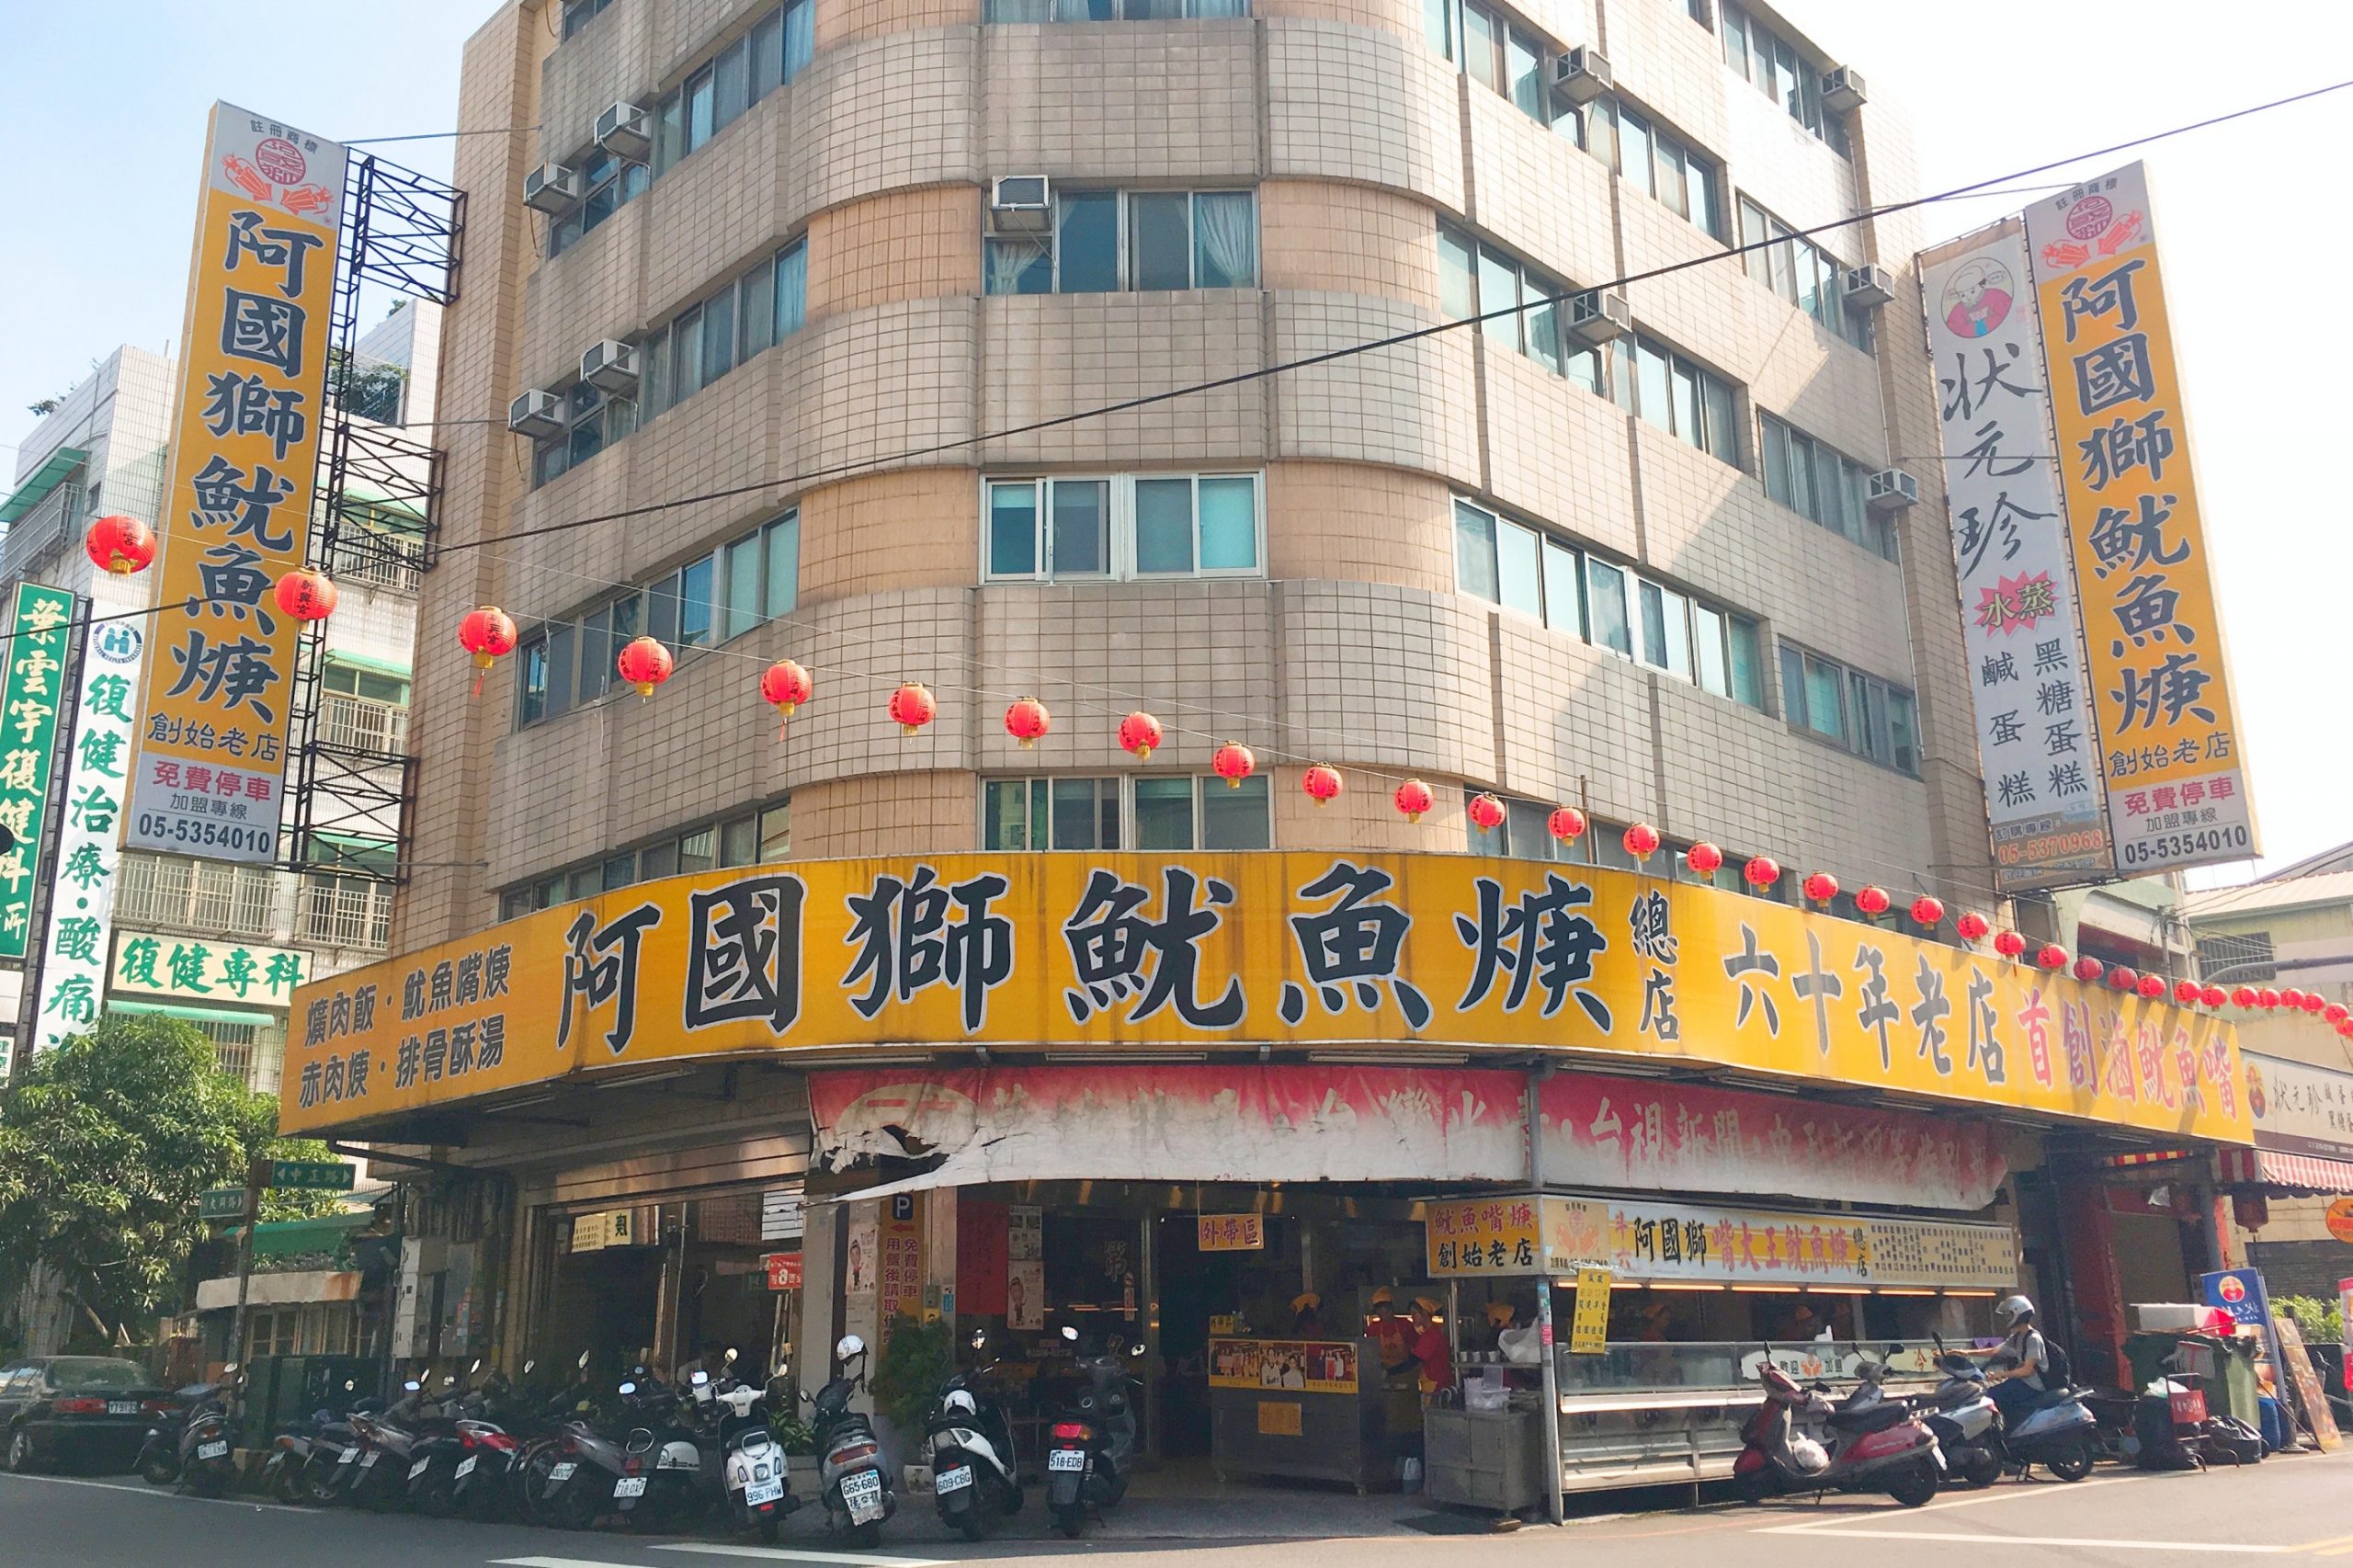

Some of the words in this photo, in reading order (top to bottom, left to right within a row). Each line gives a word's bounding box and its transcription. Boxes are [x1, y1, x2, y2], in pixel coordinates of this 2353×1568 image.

[250, 119, 318, 154] 註冊商標
[2055, 177, 2118, 210] 註冊商標
[1940, 342, 2059, 581] 狀元珍
[2061, 258, 2216, 735] 阿國獅魷魚焿
[1981, 580, 2055, 627] 水蒸
[147, 711, 281, 763] 創始老店
[1982, 651, 2037, 809] 鹹蛋糕
[2032, 637, 2088, 799] 黑糖蛋糕
[2109, 731, 2231, 778] 創始老店
[153, 760, 272, 802] 免費停車
[2124, 776, 2235, 817] 免費停車
[169, 793, 248, 820] 加盟專線
[2144, 807, 2218, 833] 加盟專線
[139, 813, 270, 854] 05-5354010
[1998, 828, 2103, 866] 05-5370968
[2124, 825, 2247, 864] 05-5354010
[118, 937, 306, 998] 復健專科
[557, 859, 1613, 1057] 阿國獅魷魚焿
[1629, 889, 1679, 1040] 總店
[1723, 922, 2006, 1085] 六十年老店
[1201, 1218, 1260, 1246] 外帶區
[1434, 1202, 1535, 1235] 魷魚嘴焿
[1438, 1236, 1534, 1269] 創始老店
[1634, 1216, 1708, 1267] 阿國獅
[903, 1239, 918, 1298] 免費停車
[842, 1475, 881, 1496] G65-680
